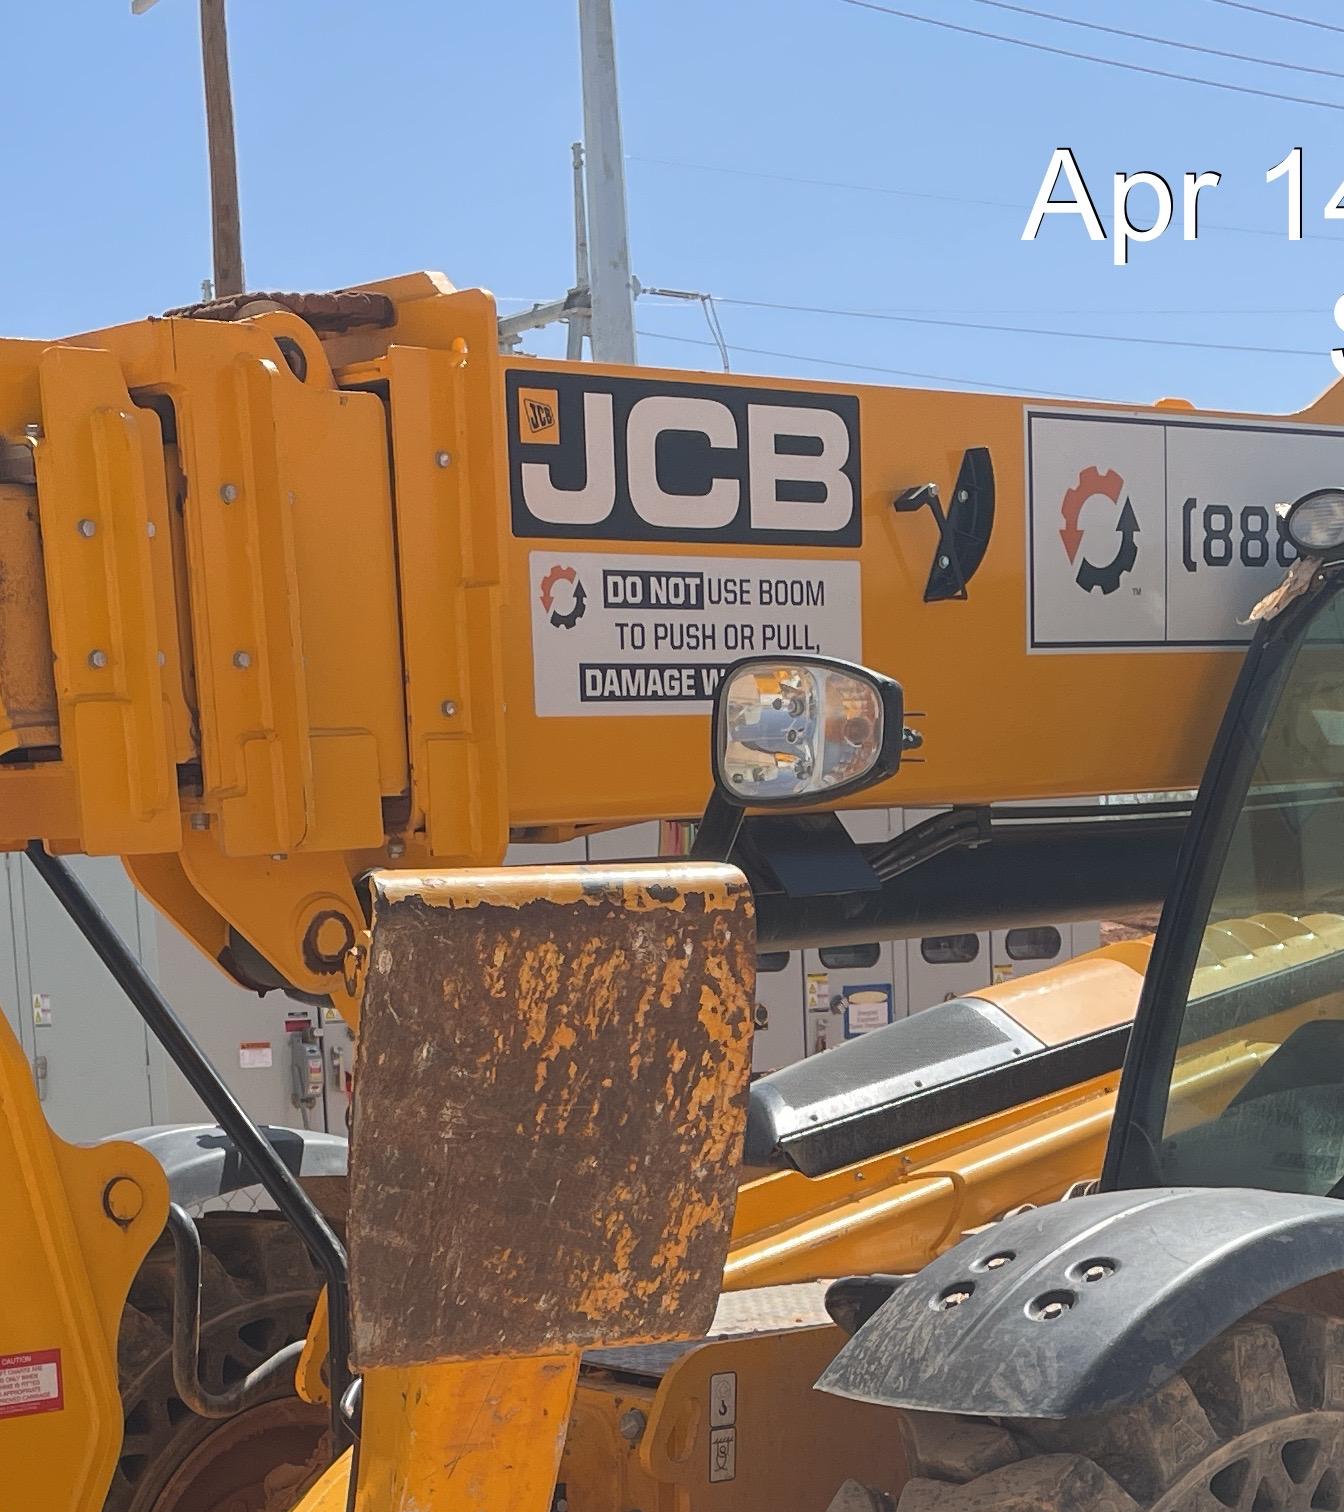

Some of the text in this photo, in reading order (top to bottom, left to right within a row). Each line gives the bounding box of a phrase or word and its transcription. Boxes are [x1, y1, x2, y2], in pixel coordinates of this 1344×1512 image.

[529, 402, 553, 430] JCB
[521, 391, 854, 532] JCB
[607, 575, 825, 607] DO NOT USE BOOM
[615, 622, 821, 655] TO PUSH OR PULL,
[585, 667, 696, 697] DAMAGE
[1, 1355, 32, 1366] CAUTION
